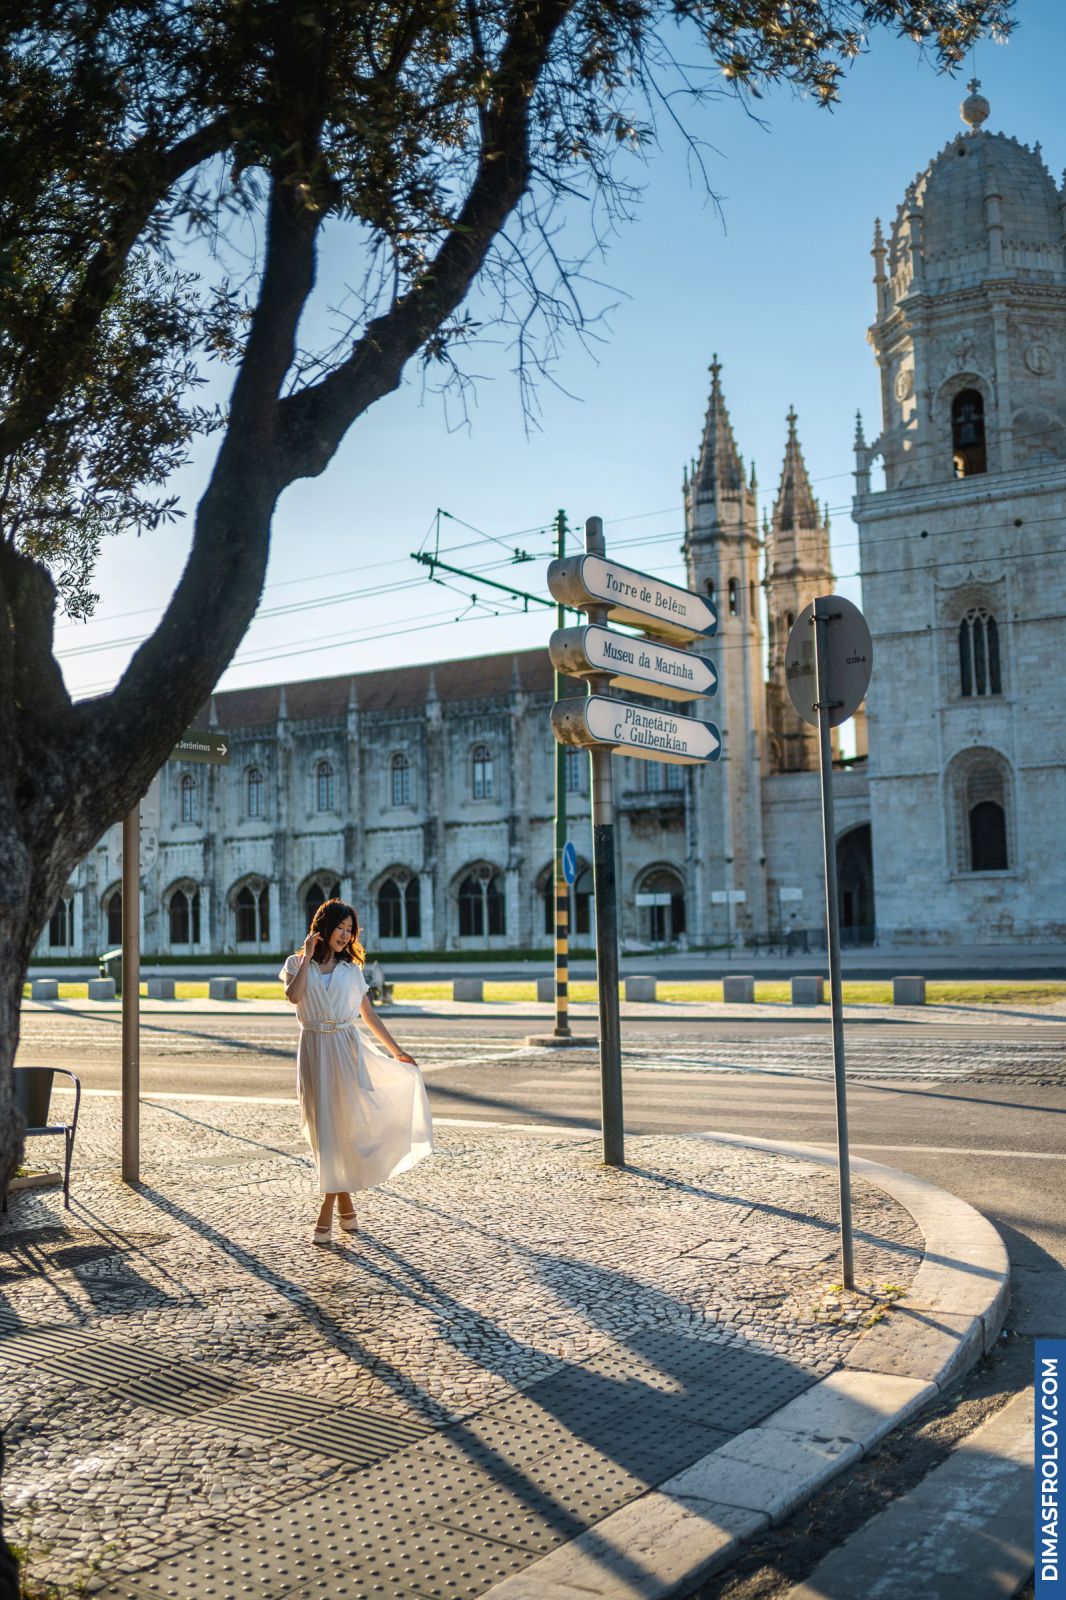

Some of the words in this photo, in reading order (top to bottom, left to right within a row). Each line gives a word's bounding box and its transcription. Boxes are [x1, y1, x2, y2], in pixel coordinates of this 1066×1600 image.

[606, 573, 637, 598] Torre
[640, 587, 652, 603] de
[655, 591, 687, 616] Belém
[603, 641, 634, 664] Museu
[639, 652, 651, 668] da
[655, 656, 694, 680] Marinha
[624, 708, 678, 734] Planetário
[180, 740, 210, 751] Jerónimos
[614, 723, 625, 740] C.
[630, 727, 688, 752] Gulbenkian
